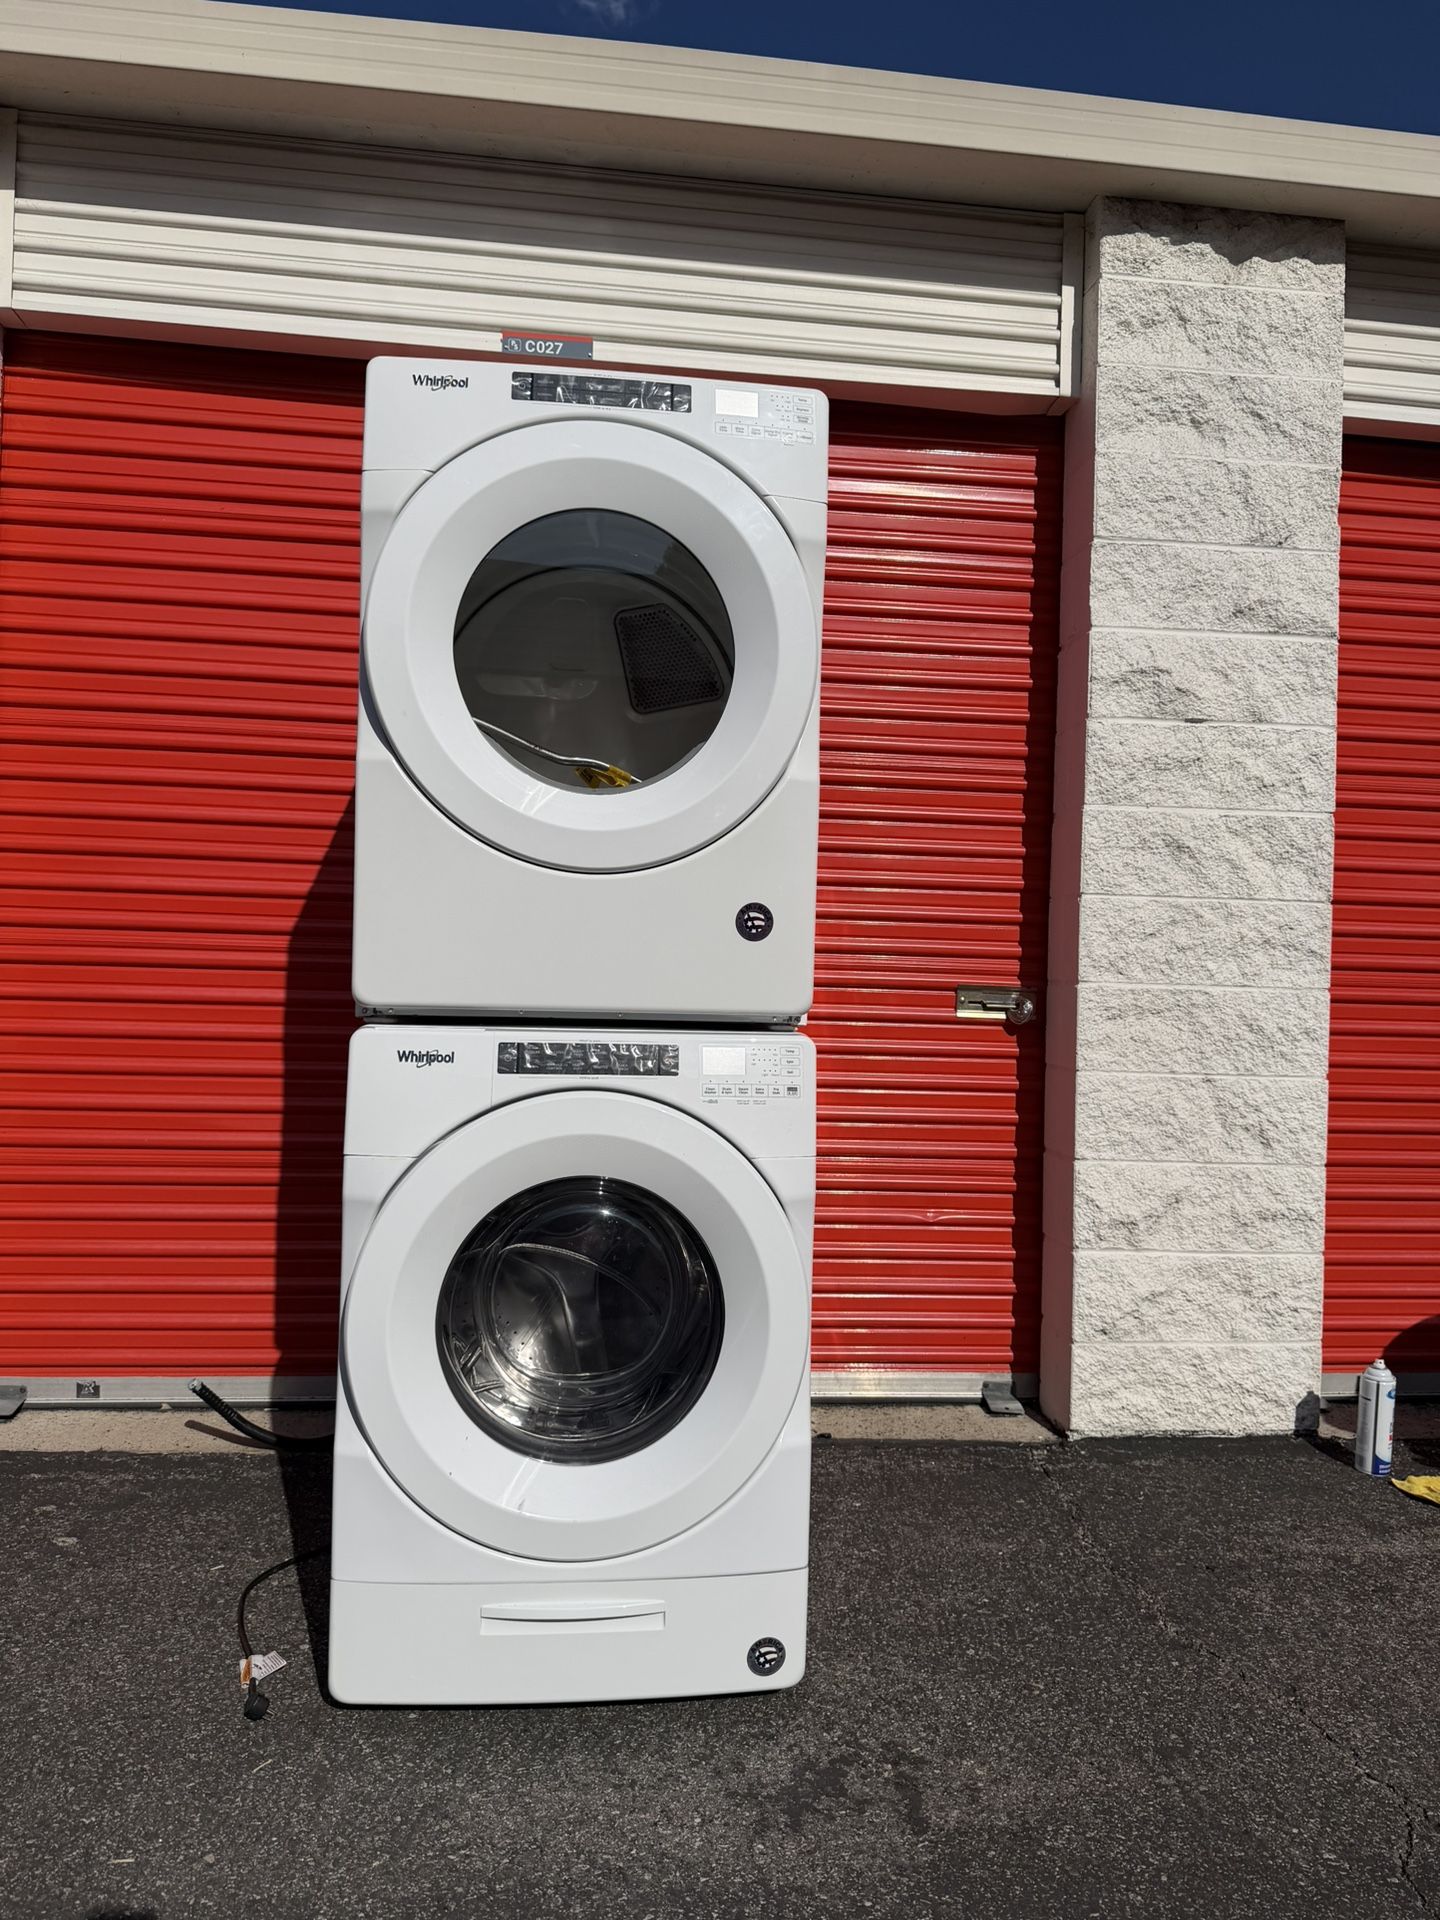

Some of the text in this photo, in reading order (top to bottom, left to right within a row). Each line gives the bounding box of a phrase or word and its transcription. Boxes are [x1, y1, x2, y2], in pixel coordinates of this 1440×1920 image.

[525, 340, 563, 355] C027
[412, 374, 469, 391] Whirlpool
[397, 1050, 455, 1068] Whirlpool
